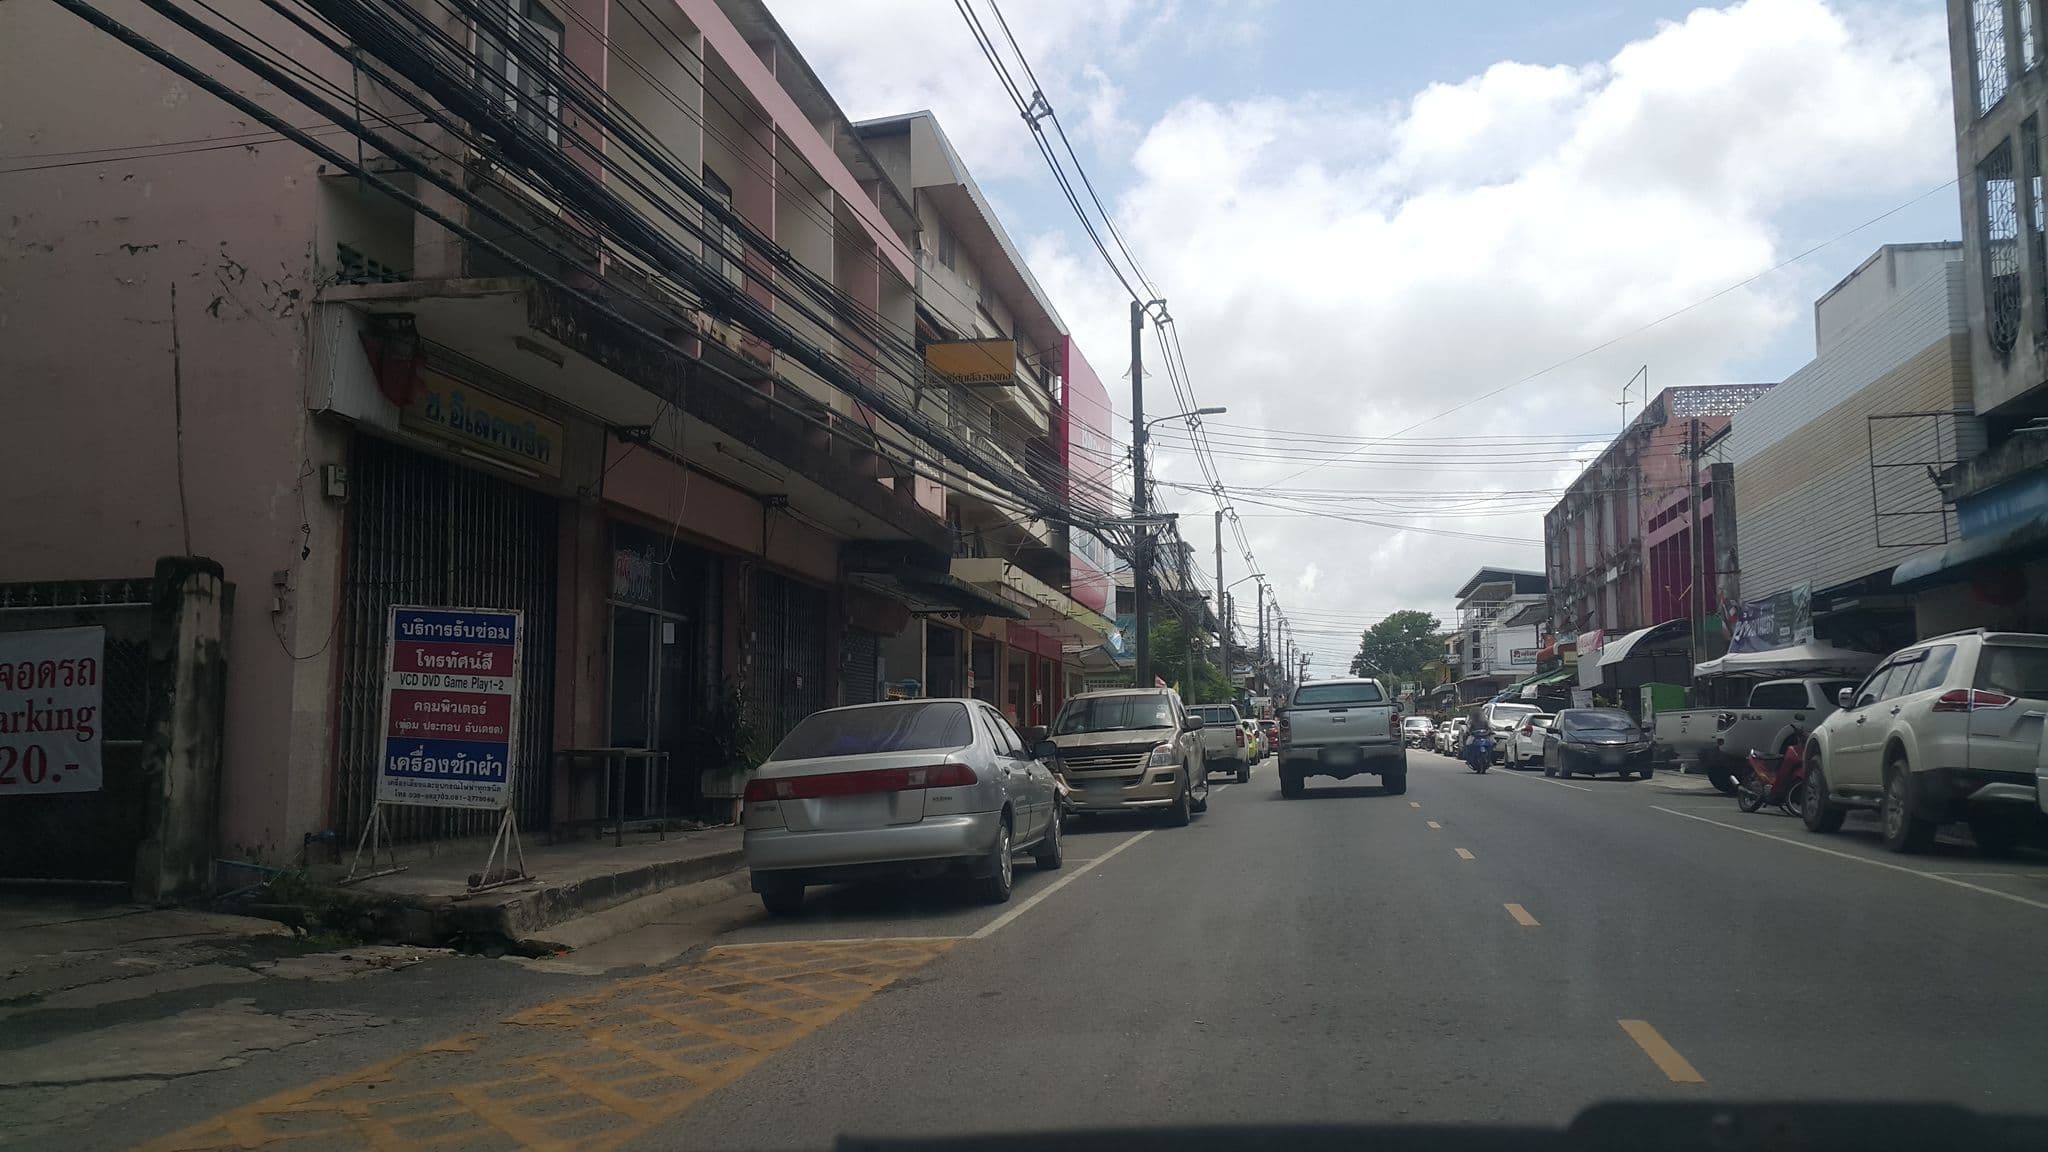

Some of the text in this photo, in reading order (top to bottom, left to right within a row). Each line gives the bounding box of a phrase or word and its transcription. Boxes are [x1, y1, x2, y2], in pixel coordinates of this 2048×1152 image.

[401, 617, 510, 640] บริการรับซ่อม
[415, 648, 494, 671] โทรทัศน์สี
[399, 673, 419, 686] VCD
[422, 674, 441, 687] DVD
[444, 675, 468, 689] Game
[414, 698, 487, 716] คอมพิวเตอร์
[389, 744, 503, 777] เครื่องซักผ้า
